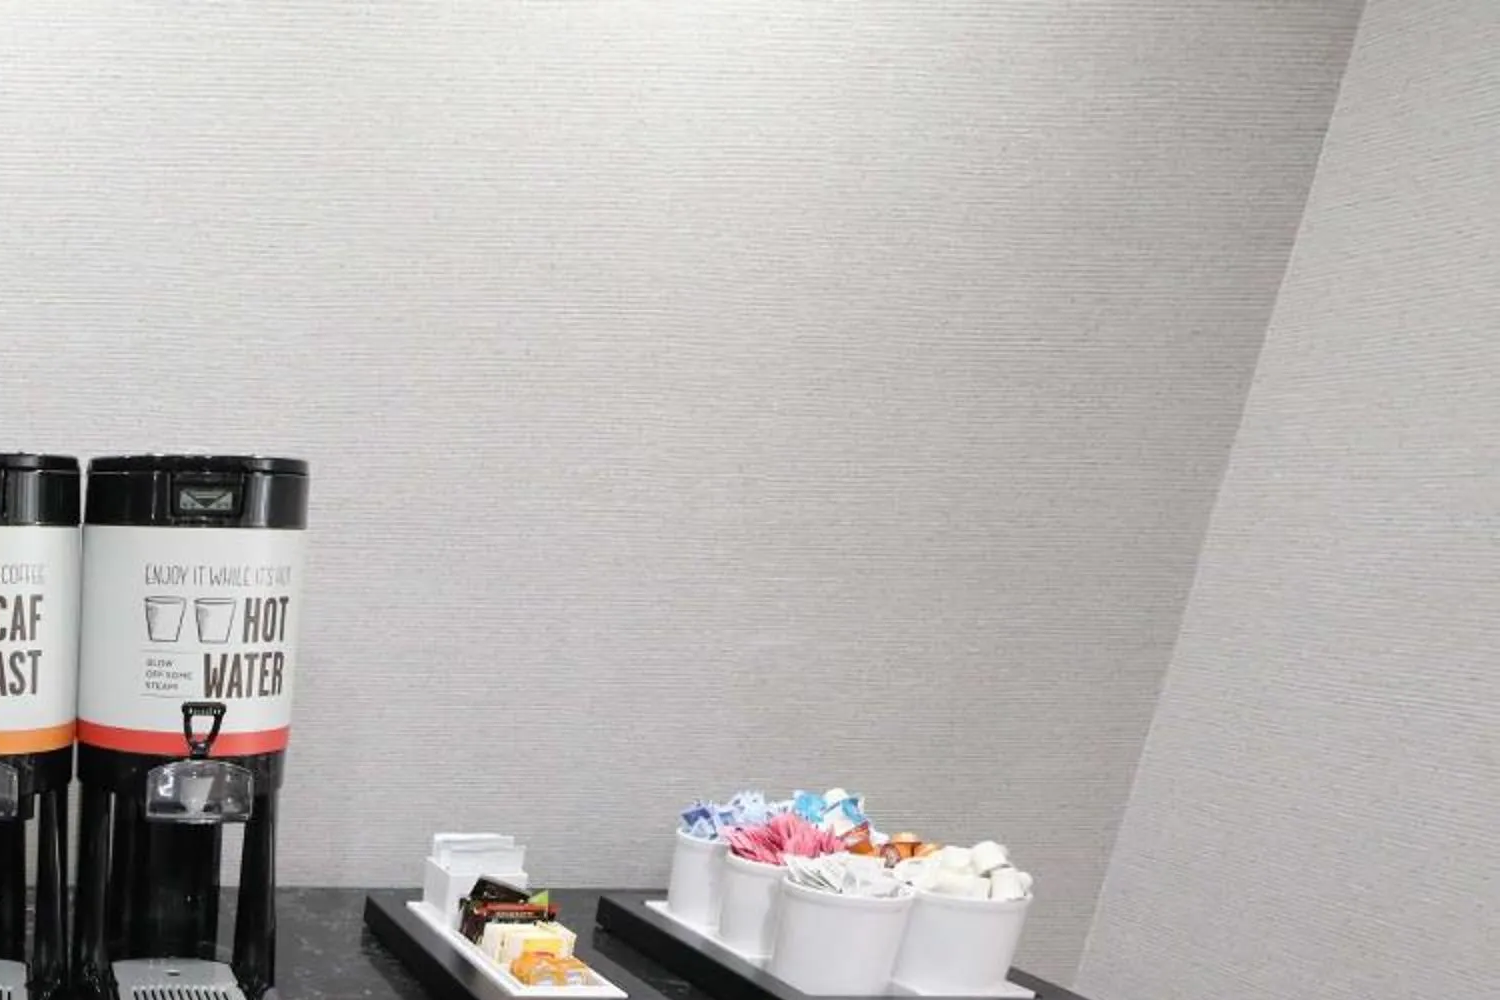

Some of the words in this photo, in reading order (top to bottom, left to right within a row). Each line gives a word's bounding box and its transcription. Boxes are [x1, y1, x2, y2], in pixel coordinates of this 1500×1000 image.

[145, 565, 188, 585] ENJOY
[193, 566, 206, 585] IT
[242, 596, 289, 643] HOT
[204, 651, 285, 698] WATER
